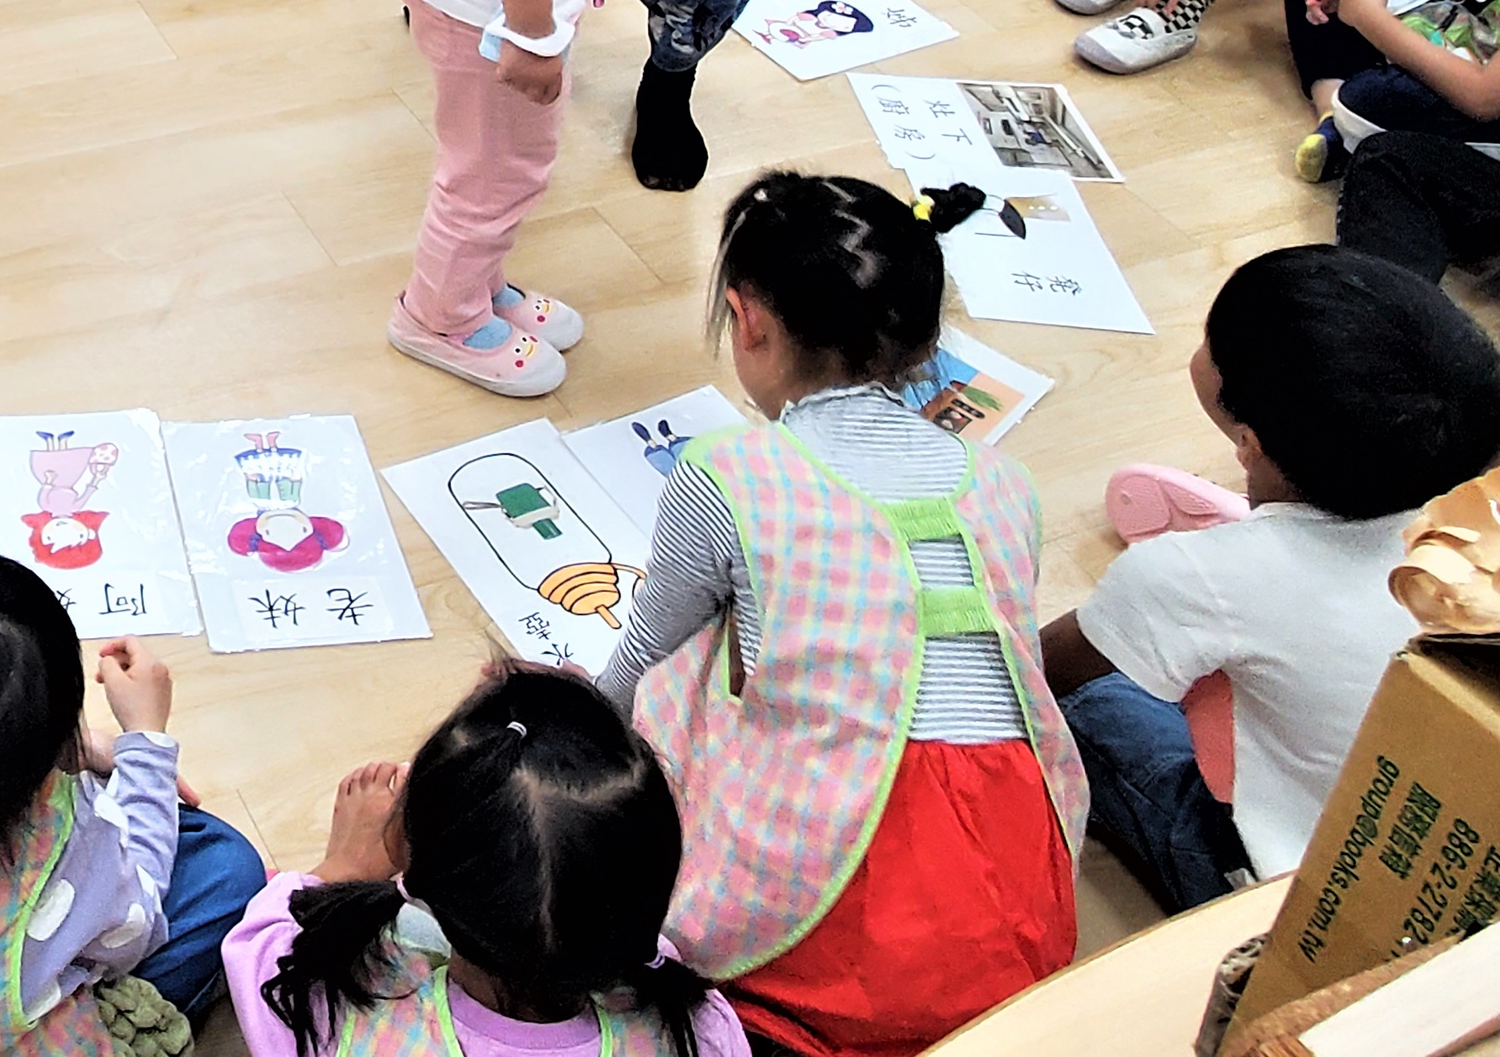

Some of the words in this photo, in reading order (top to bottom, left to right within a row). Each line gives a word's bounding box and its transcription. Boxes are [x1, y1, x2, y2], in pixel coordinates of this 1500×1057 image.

[250, 586, 375, 628] 老妹
[1299, 755, 1400, 963] group@books.com.tw
[1378, 782, 1445, 880] 服務信箱
